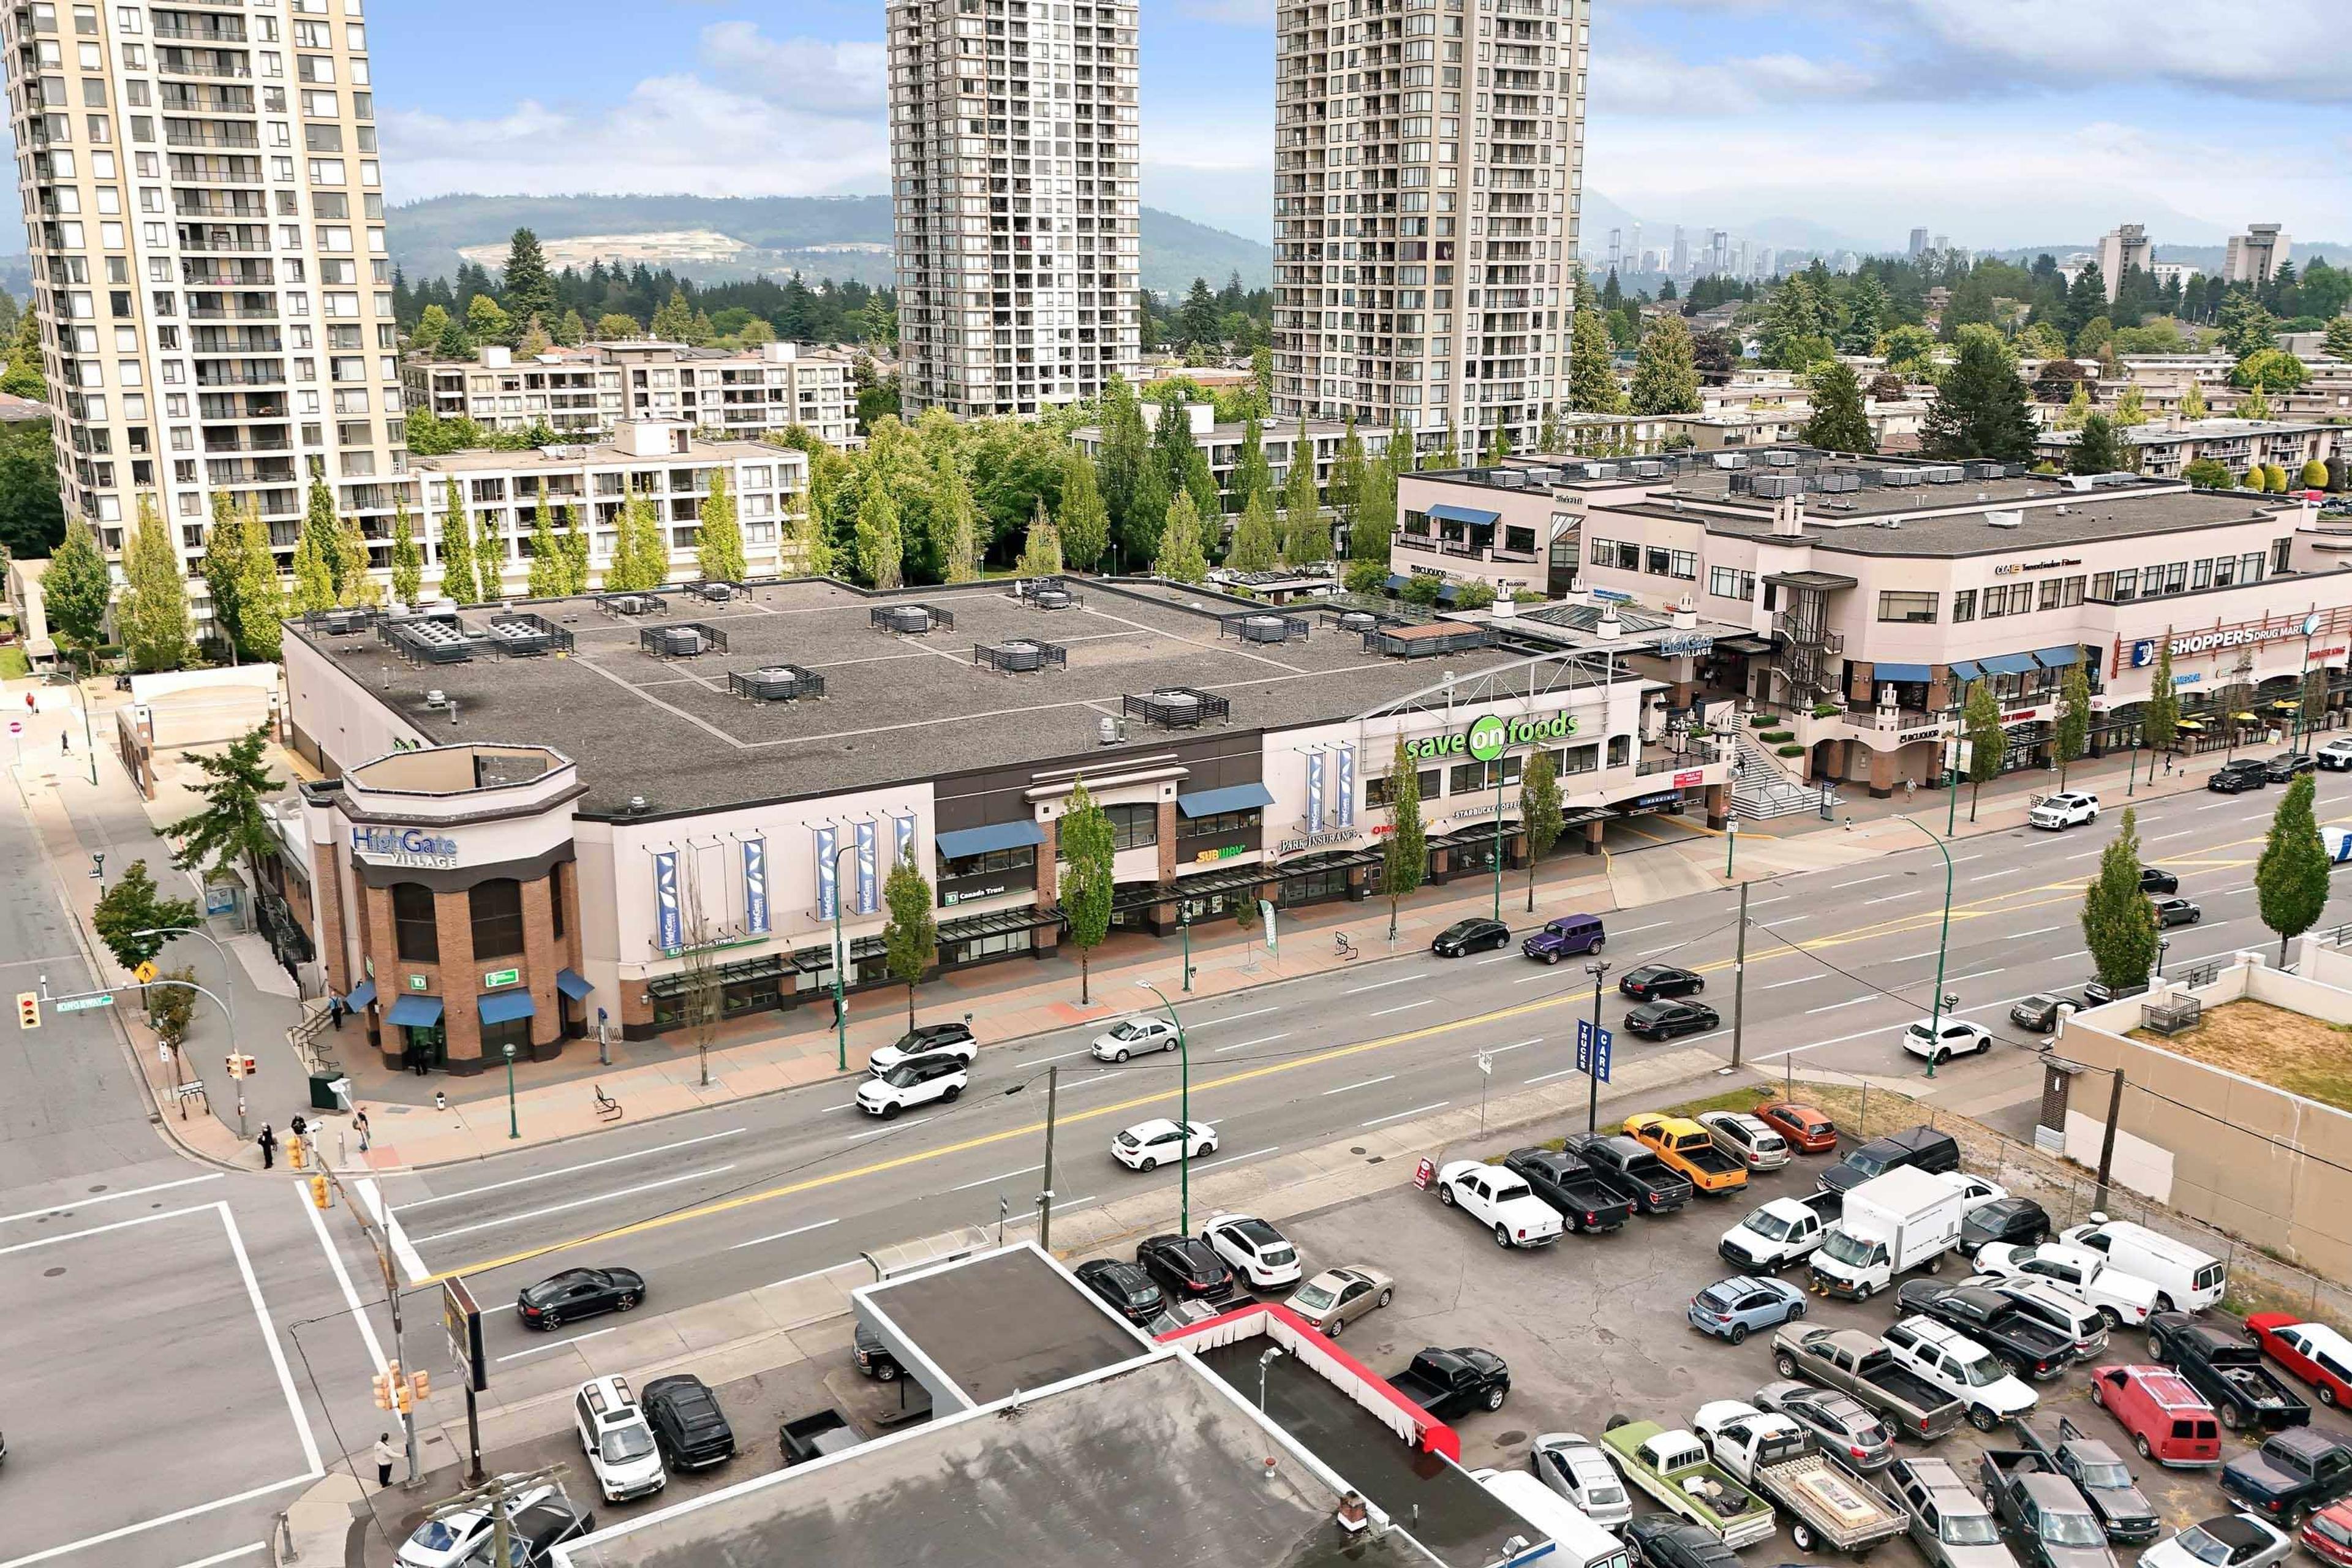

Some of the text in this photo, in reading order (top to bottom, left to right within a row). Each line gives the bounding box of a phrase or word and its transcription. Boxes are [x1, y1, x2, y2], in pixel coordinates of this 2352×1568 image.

[2170, 625, 2303, 655] SHOPPERS DRUG MART
[1679, 647, 1712, 658] VILLAGE
[1406, 710, 1580, 760] save on foods
[1455, 806, 1494, 818] STARBUCKS
[353, 827, 458, 854] HighGate
[1280, 839, 1305, 852] PARK
[391, 853, 457, 867] VILLAGE
[1196, 843, 1245, 862] SUBWAY
[959, 889, 985, 900] Canada
[986, 886, 1005, 895] Trust
[1599, 1034, 1607, 1077] CARS
